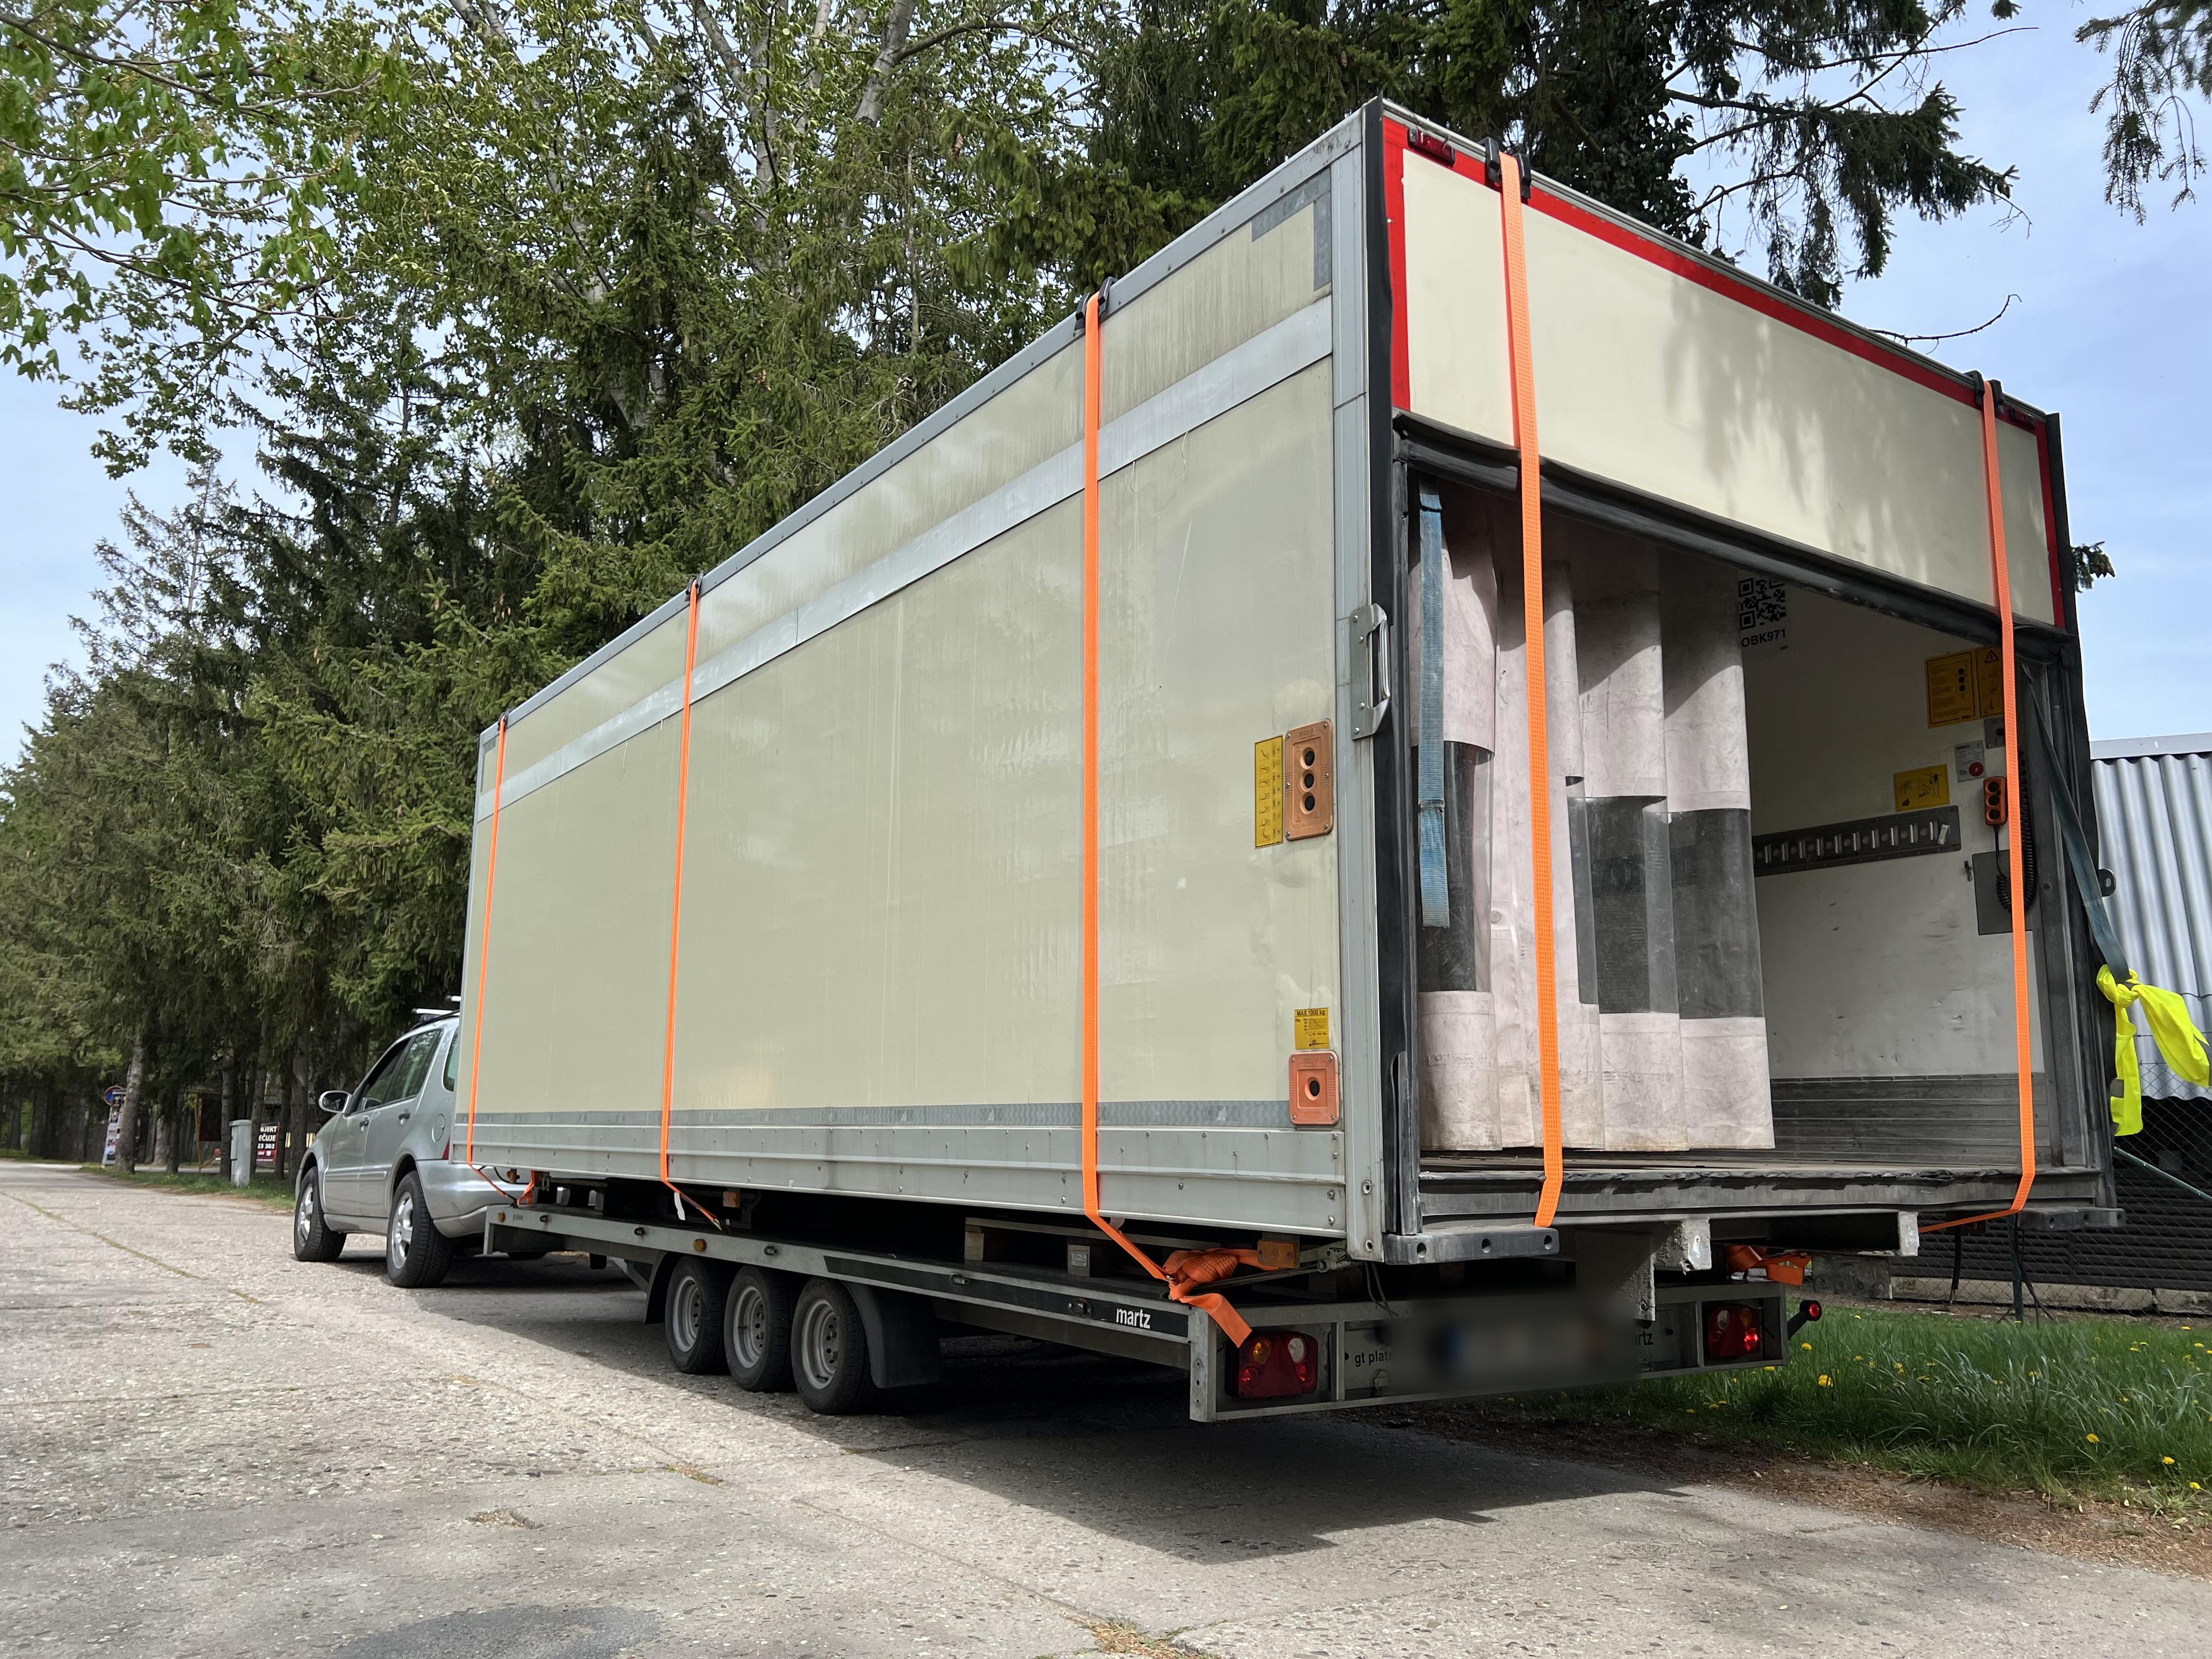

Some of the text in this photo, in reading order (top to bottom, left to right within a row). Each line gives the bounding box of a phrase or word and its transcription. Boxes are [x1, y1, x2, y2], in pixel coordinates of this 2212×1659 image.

[1741, 628, 1786, 648] OBK971
[1116, 1308, 1151, 1329] martz
[1355, 1352, 1365, 1367] gt
